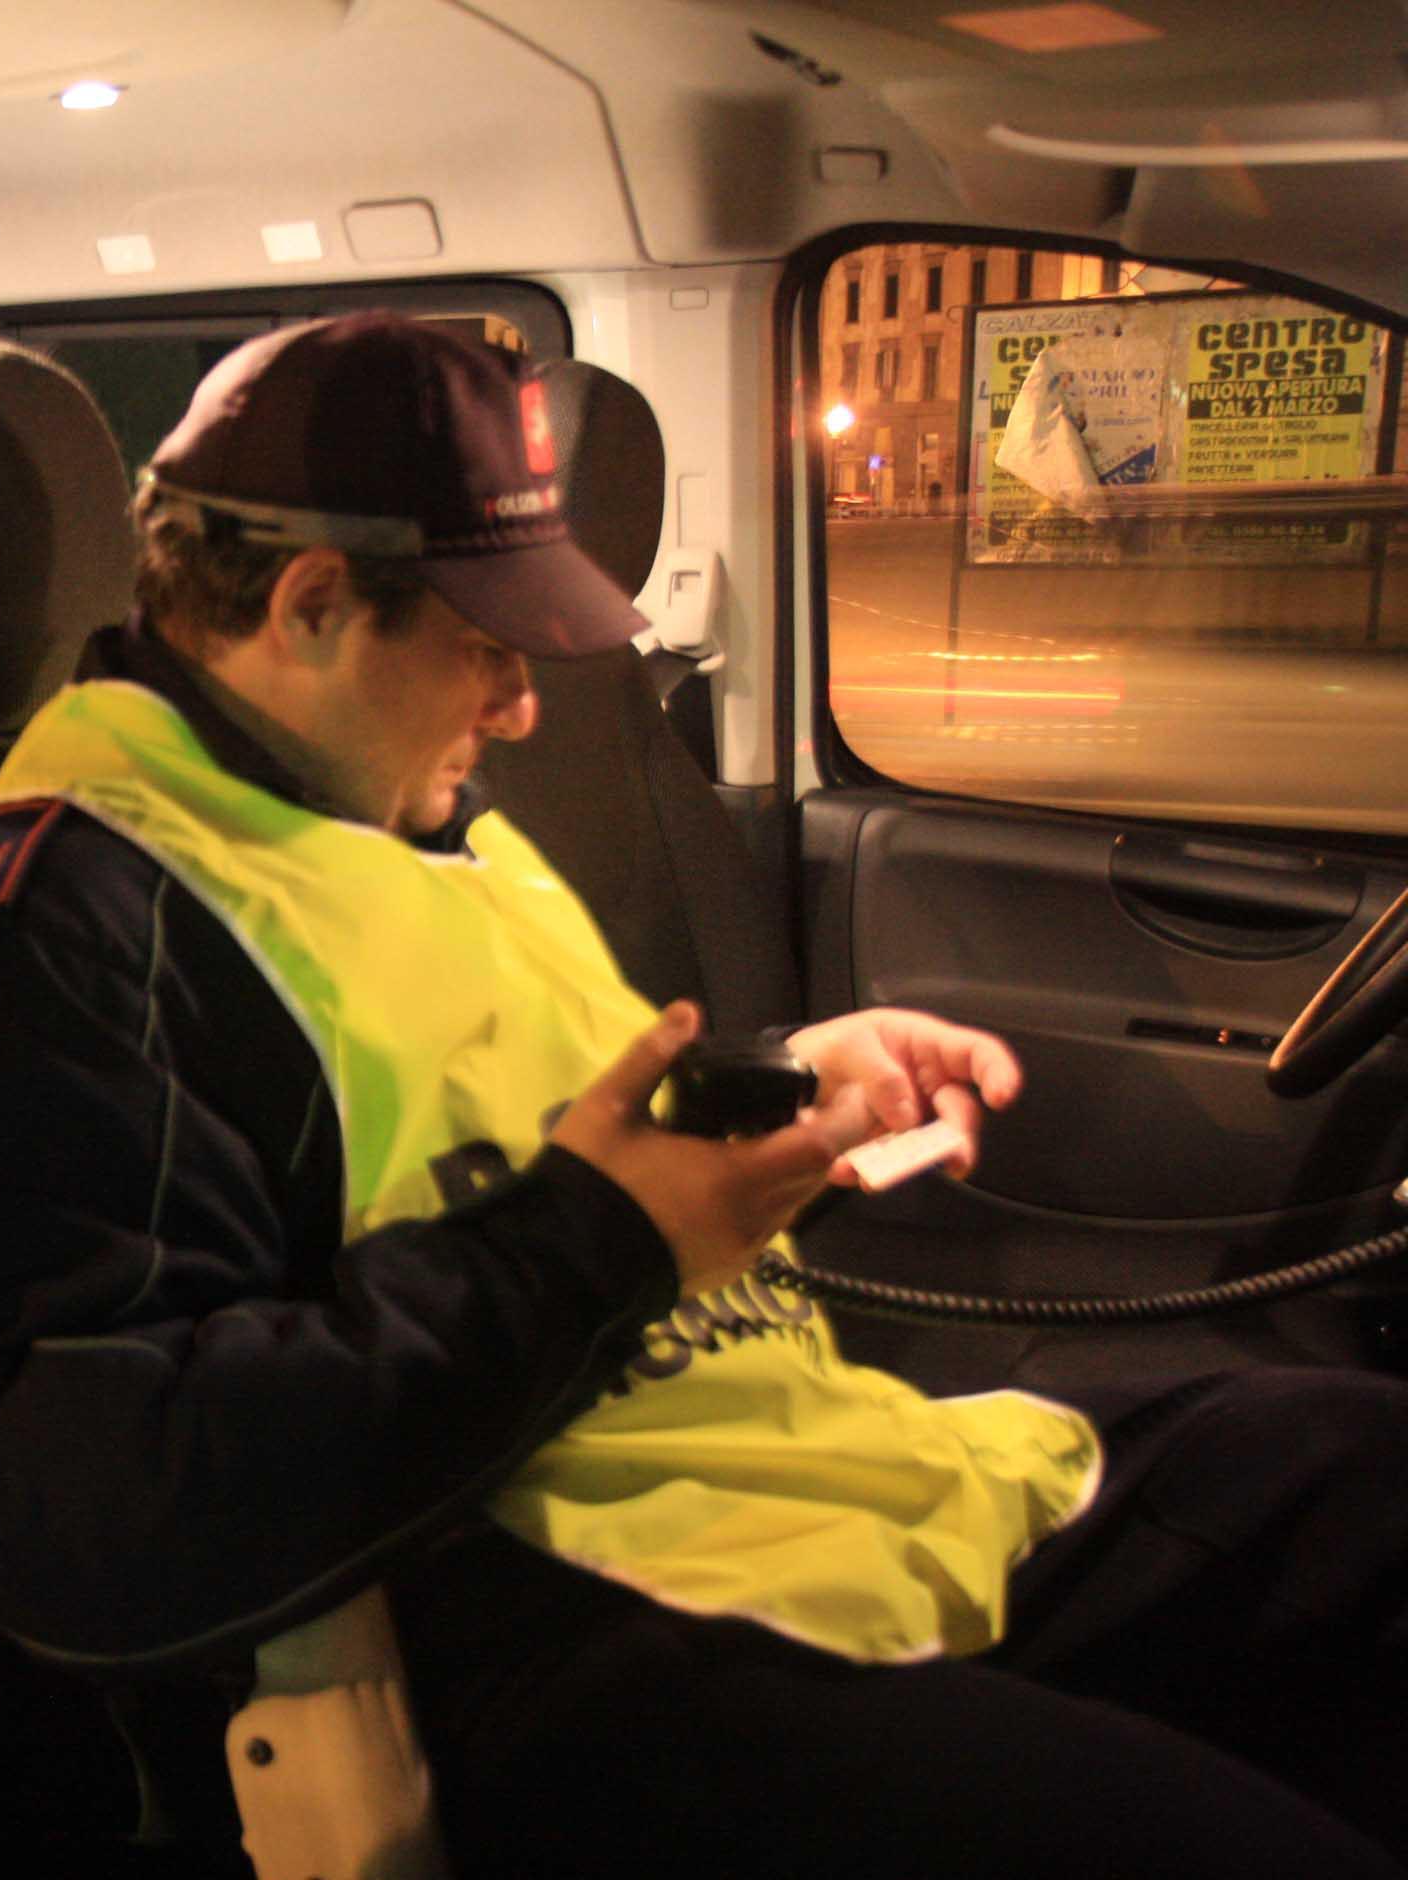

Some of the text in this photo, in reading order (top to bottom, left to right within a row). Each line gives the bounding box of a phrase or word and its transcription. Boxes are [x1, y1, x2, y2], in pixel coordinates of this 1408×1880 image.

[1191, 378, 1363, 401] NUOVA APERTURA
[1210, 398, 1339, 417] DAL 2 MARZO
